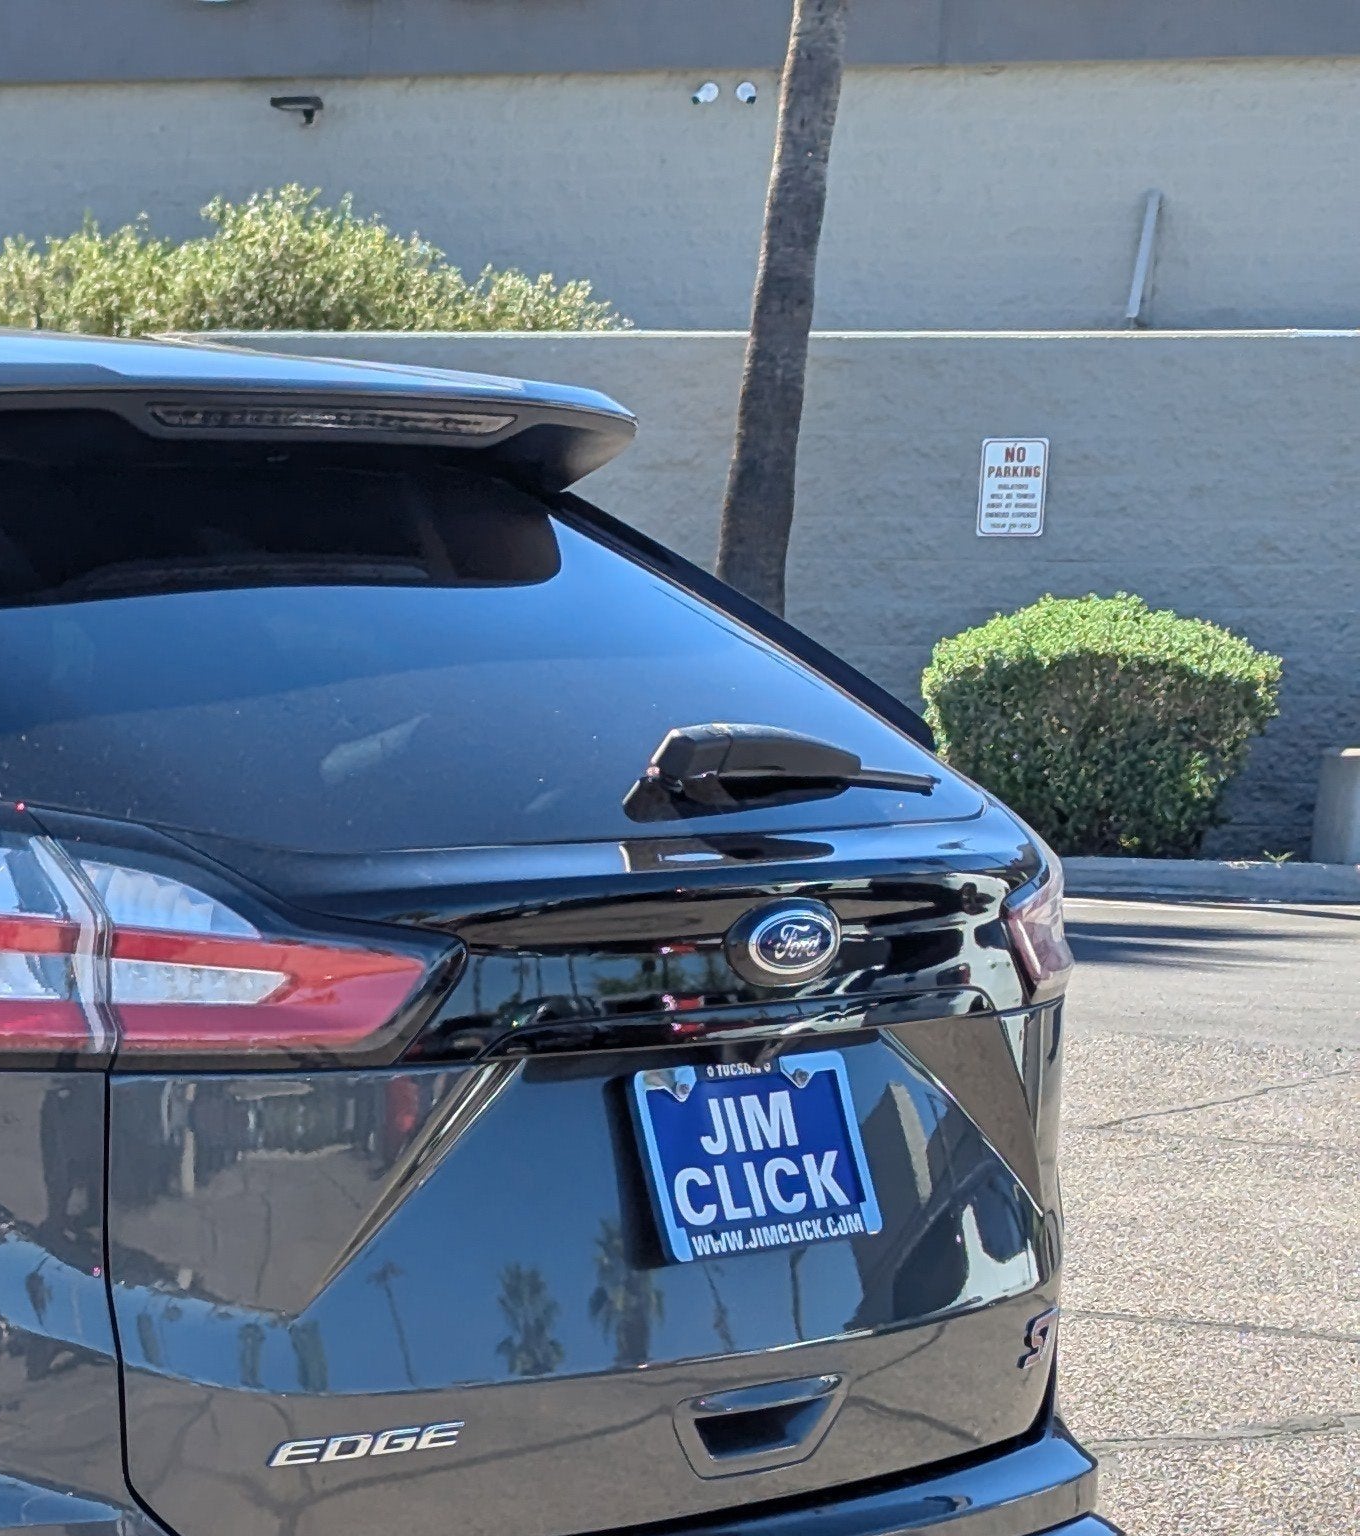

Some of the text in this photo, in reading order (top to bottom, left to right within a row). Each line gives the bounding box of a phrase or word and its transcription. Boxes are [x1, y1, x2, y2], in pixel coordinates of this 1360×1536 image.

[987, 465, 1041, 478] PARKING
[1004, 446, 1026, 463] NO
[700, 1090, 799, 1155] JIM
[674, 1150, 851, 1226] CLICK
[267, 1420, 466, 1467] EDGE
